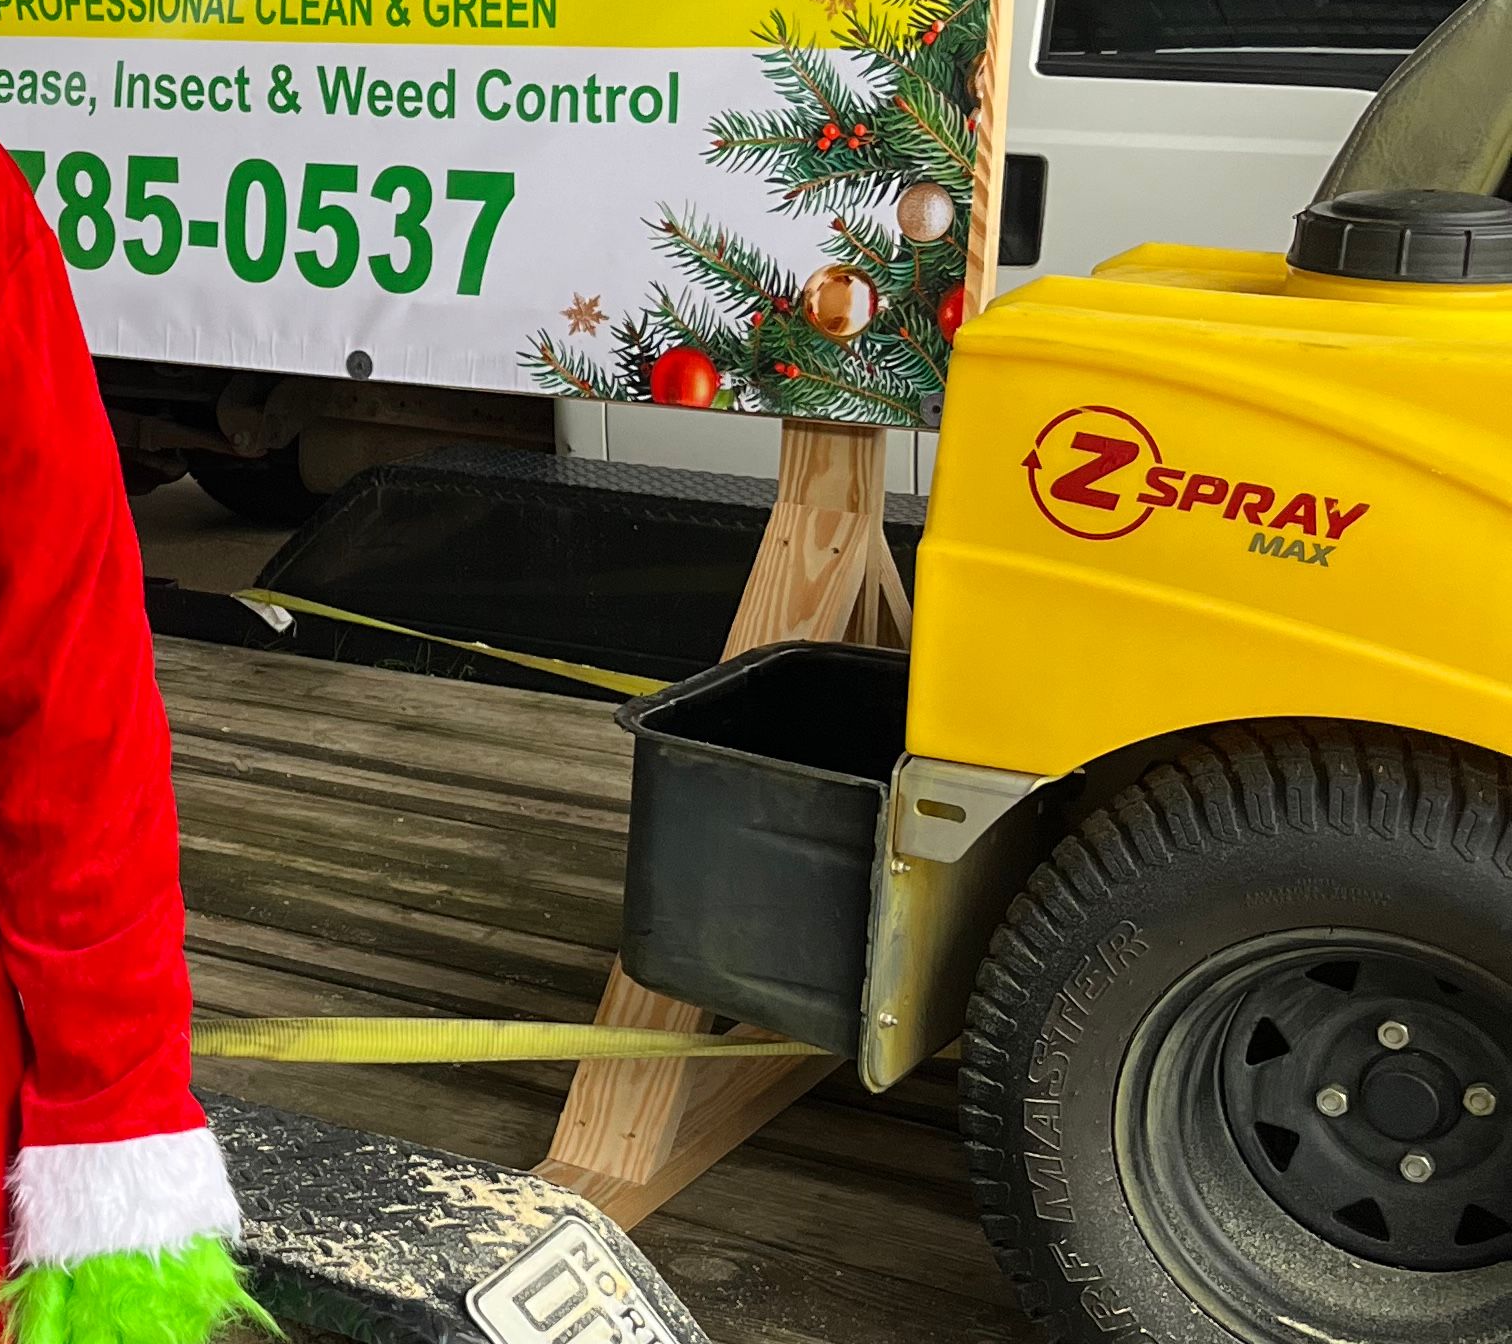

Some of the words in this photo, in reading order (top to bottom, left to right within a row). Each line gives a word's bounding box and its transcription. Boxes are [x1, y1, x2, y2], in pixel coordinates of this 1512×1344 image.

[114, 59, 252, 115] Insect
[268, 64, 303, 116] &
[317, 64, 458, 121] Weed
[475, 68, 681, 126] Control
[1050, 430, 1140, 512] Z
[1137, 465, 1371, 541] SPRAY
[1247, 532, 1337, 568] MAX
[1023, 919, 1151, 1225] MASTER
